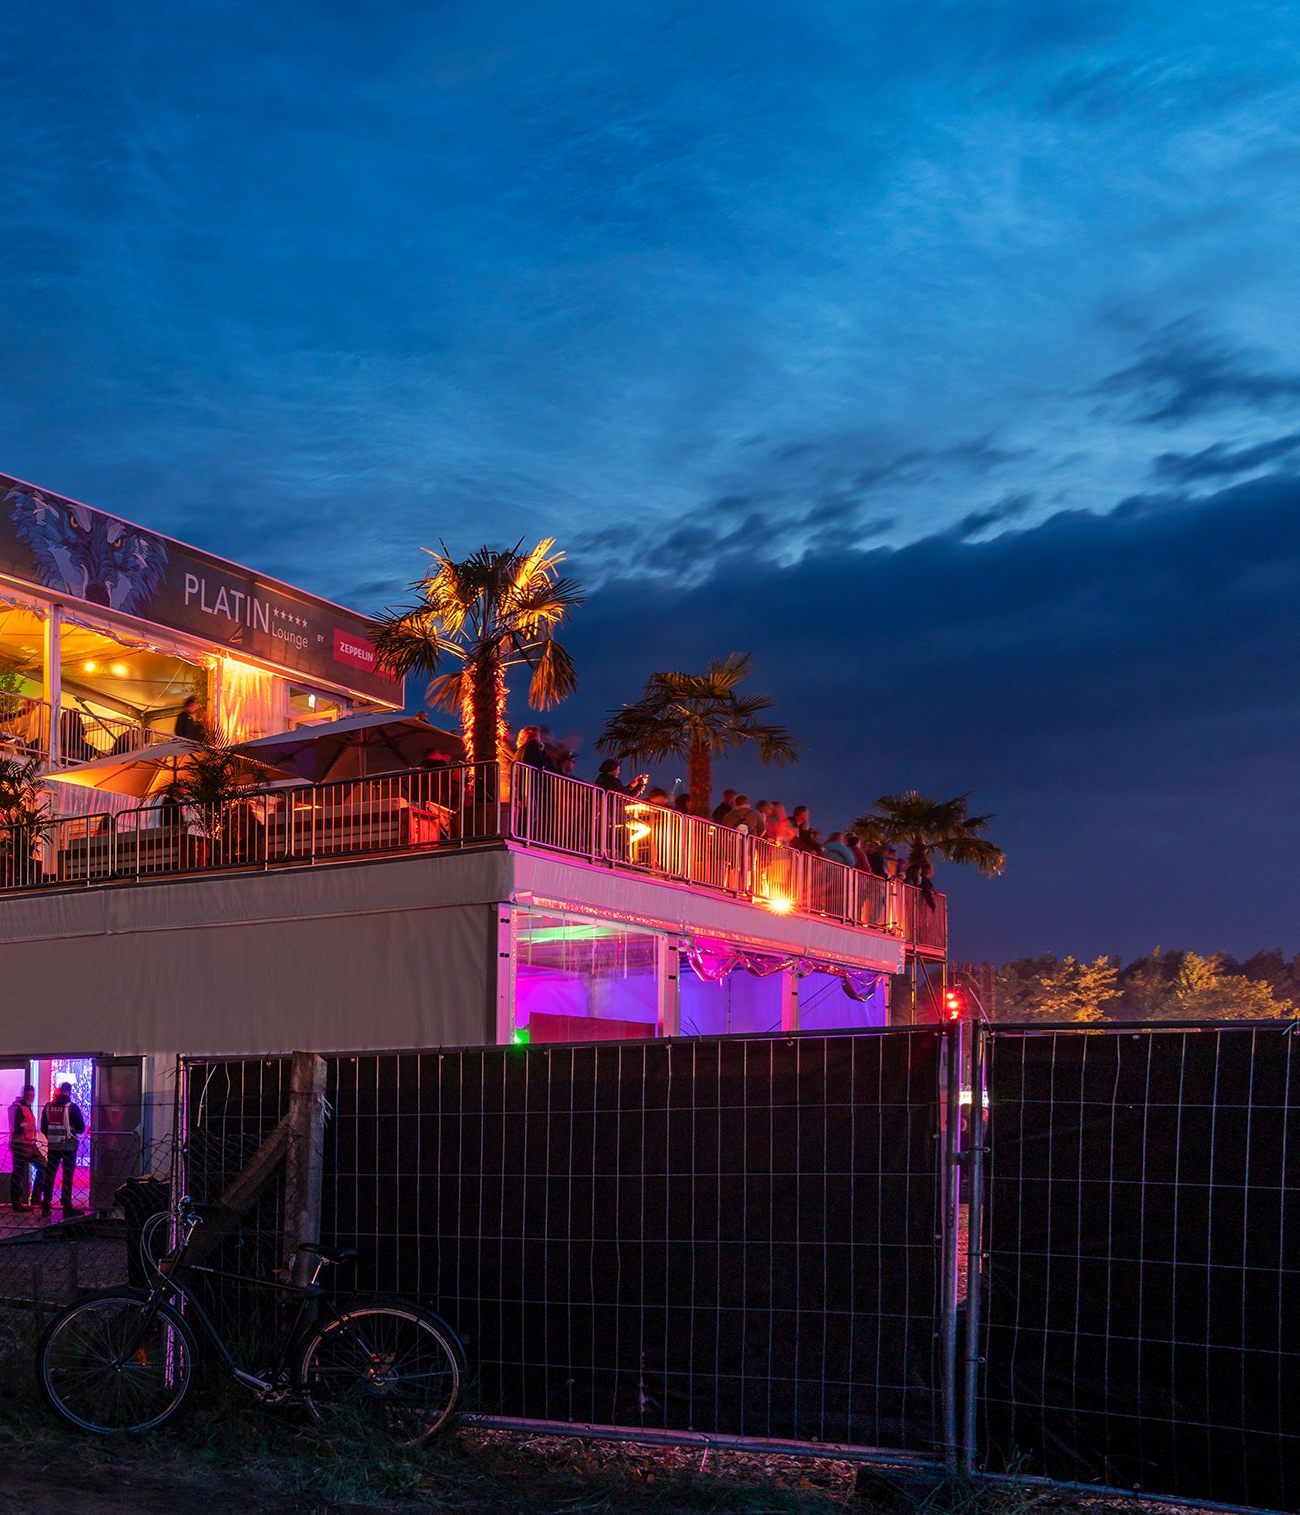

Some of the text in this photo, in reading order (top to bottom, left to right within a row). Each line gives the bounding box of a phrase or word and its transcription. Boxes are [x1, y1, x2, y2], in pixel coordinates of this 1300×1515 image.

[184, 572, 309, 650] PLATIN Lounge
[316, 634, 374, 663] BY ZEPPELIN
